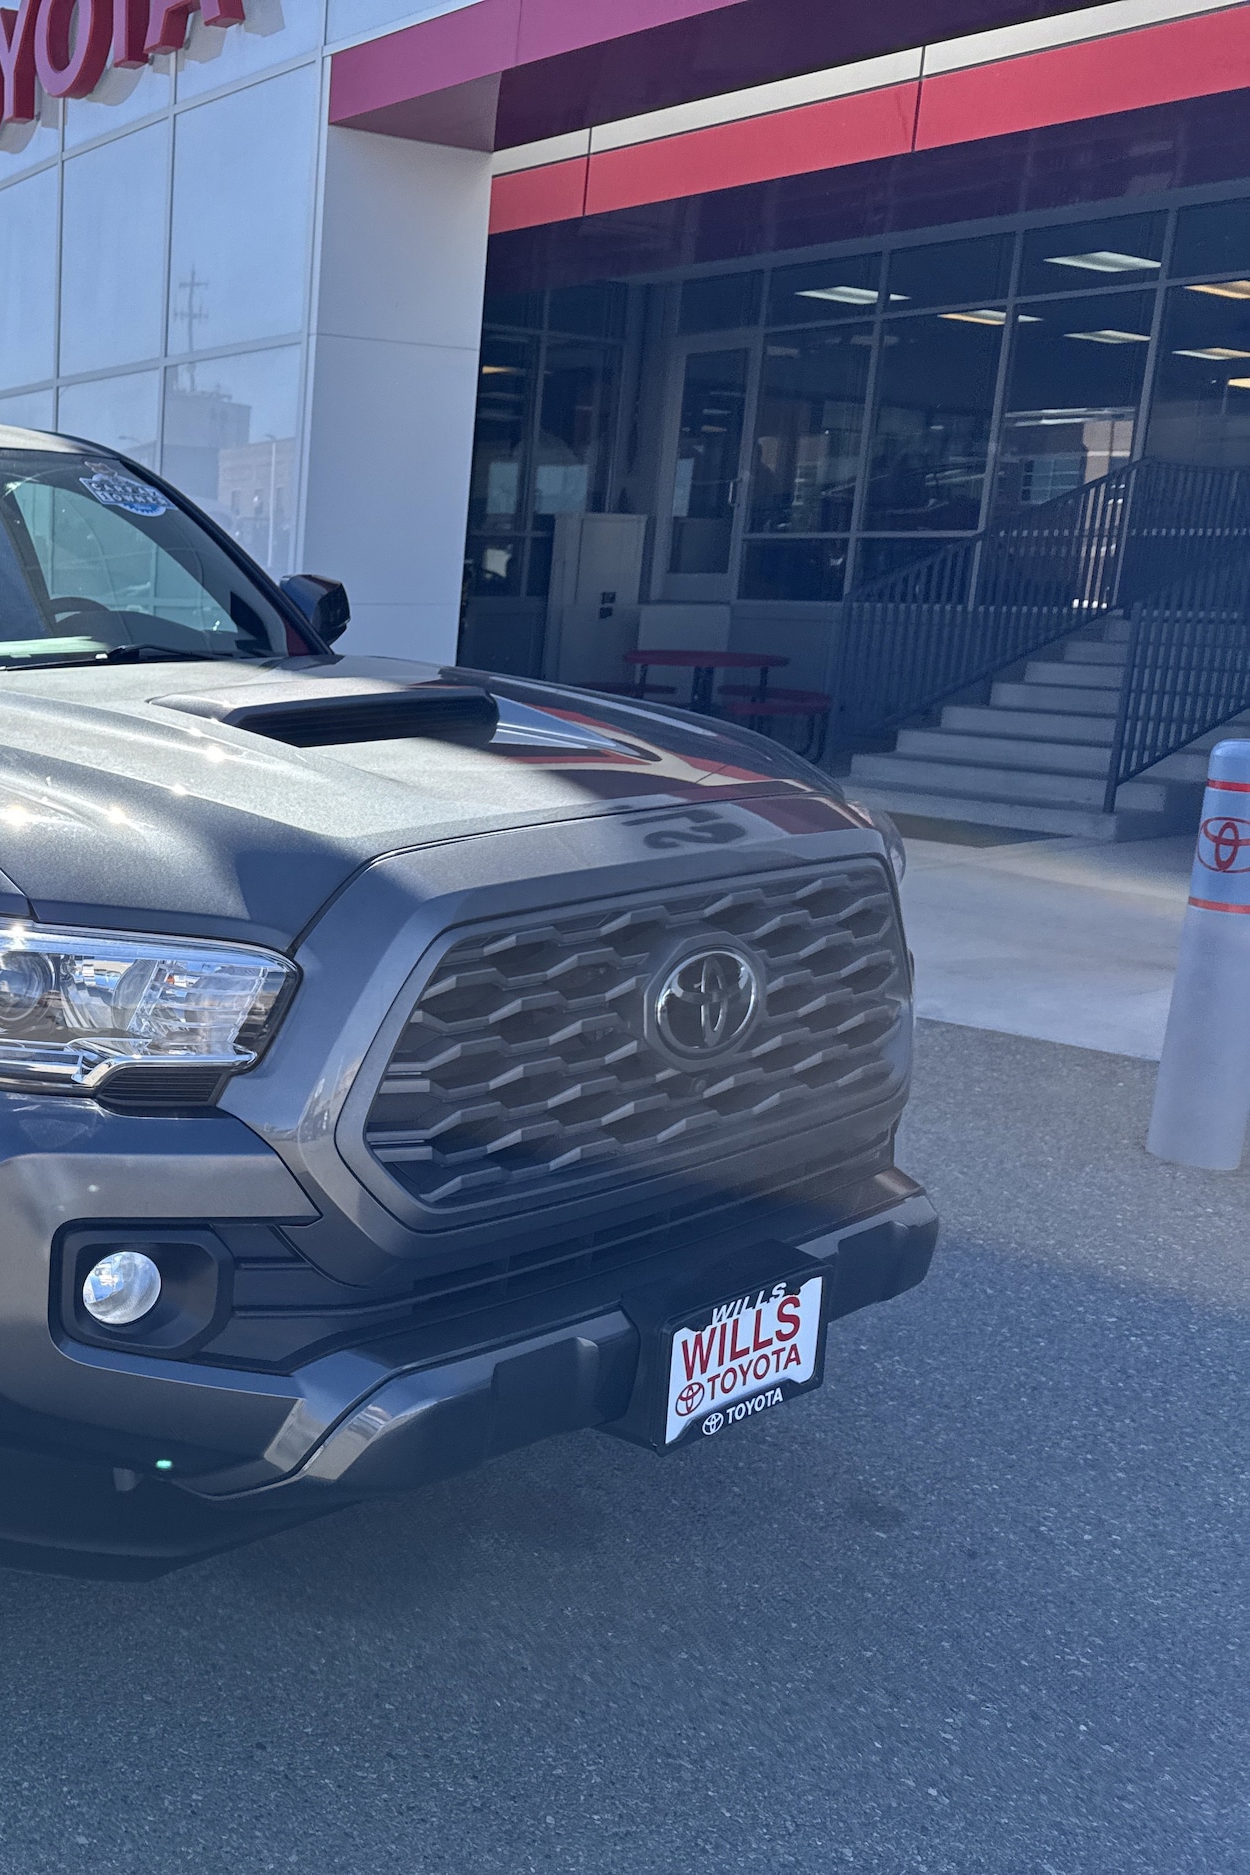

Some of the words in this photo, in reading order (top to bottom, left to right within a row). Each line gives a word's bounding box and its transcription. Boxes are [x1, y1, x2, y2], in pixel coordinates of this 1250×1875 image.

[712, 1282, 787, 1326] WILLS
[682, 1296, 801, 1381] WILLS
[707, 1343, 802, 1400] TOYOTA
[726, 1387, 784, 1424] TOYOTA
